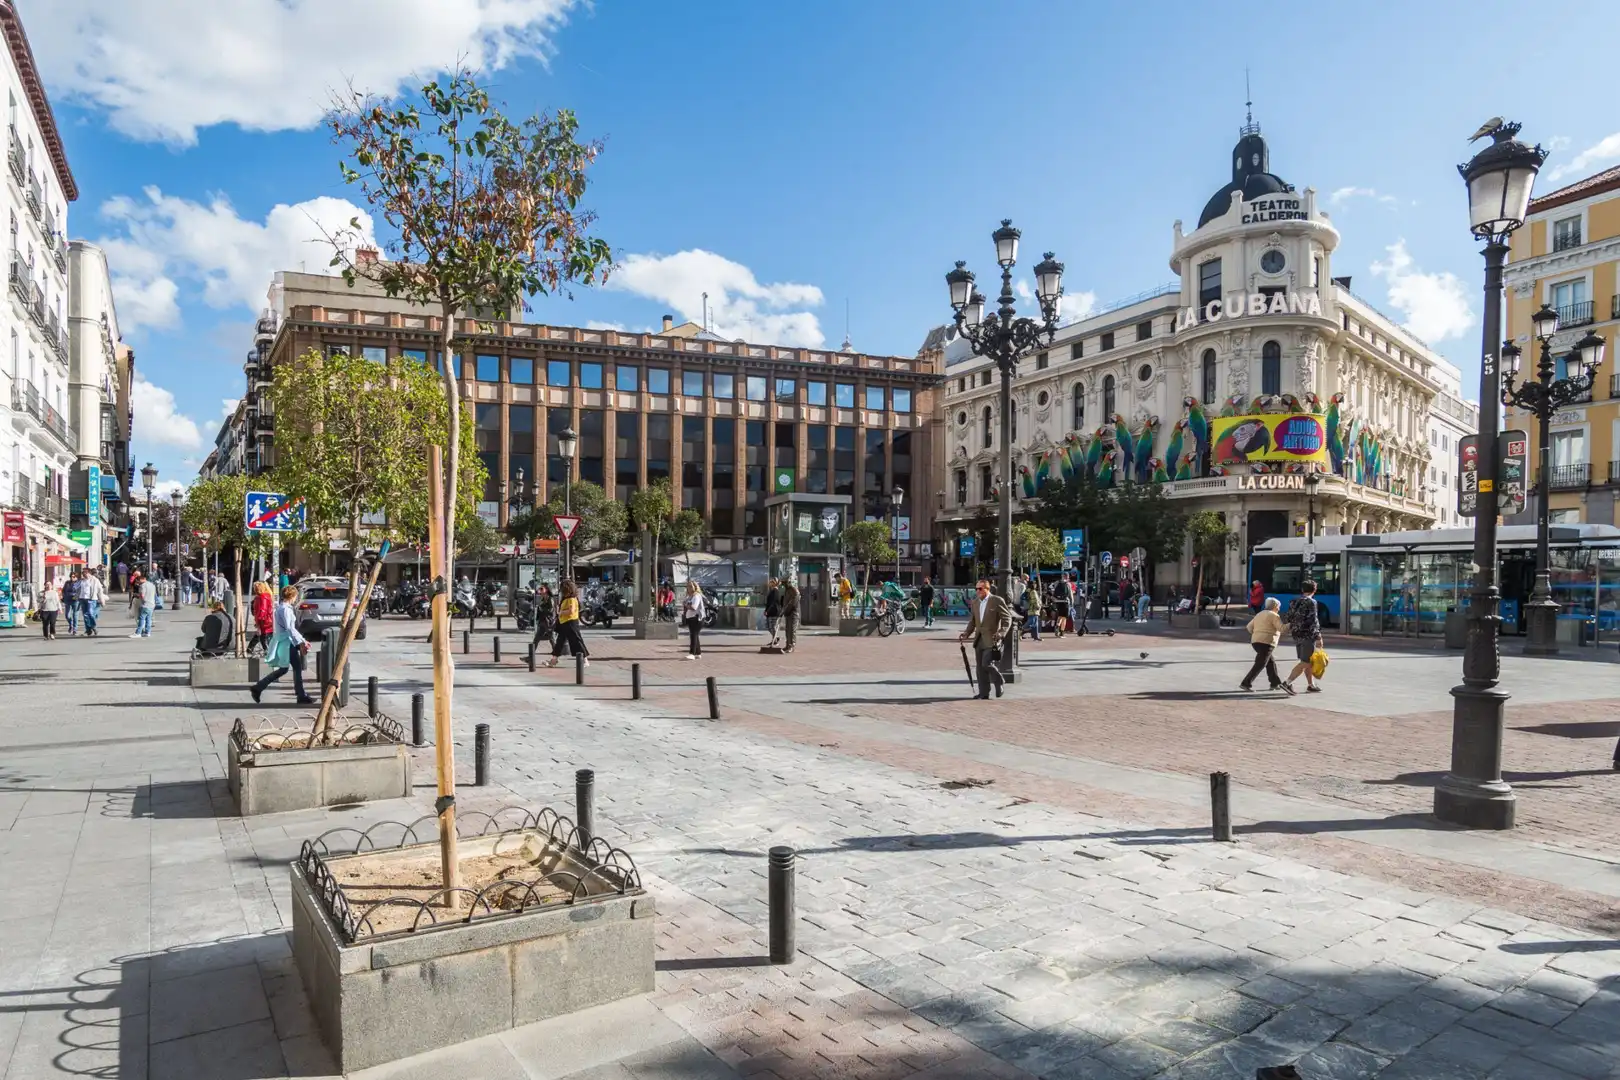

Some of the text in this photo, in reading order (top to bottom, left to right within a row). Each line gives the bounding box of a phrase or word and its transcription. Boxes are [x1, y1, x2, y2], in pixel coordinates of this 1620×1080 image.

[1250, 199, 1300, 212] TEATRO
[1242, 211, 1309, 224] CALDERON
[1176, 289, 1322, 331] LA CUBANA
[1288, 418, 1318, 435] ADIÓS
[1283, 434, 1320, 450] ARTURO
[1238, 475, 1304, 490] LA CUBAN
[961, 541, 968, 549] P
[1064, 536, 1073, 547] P
